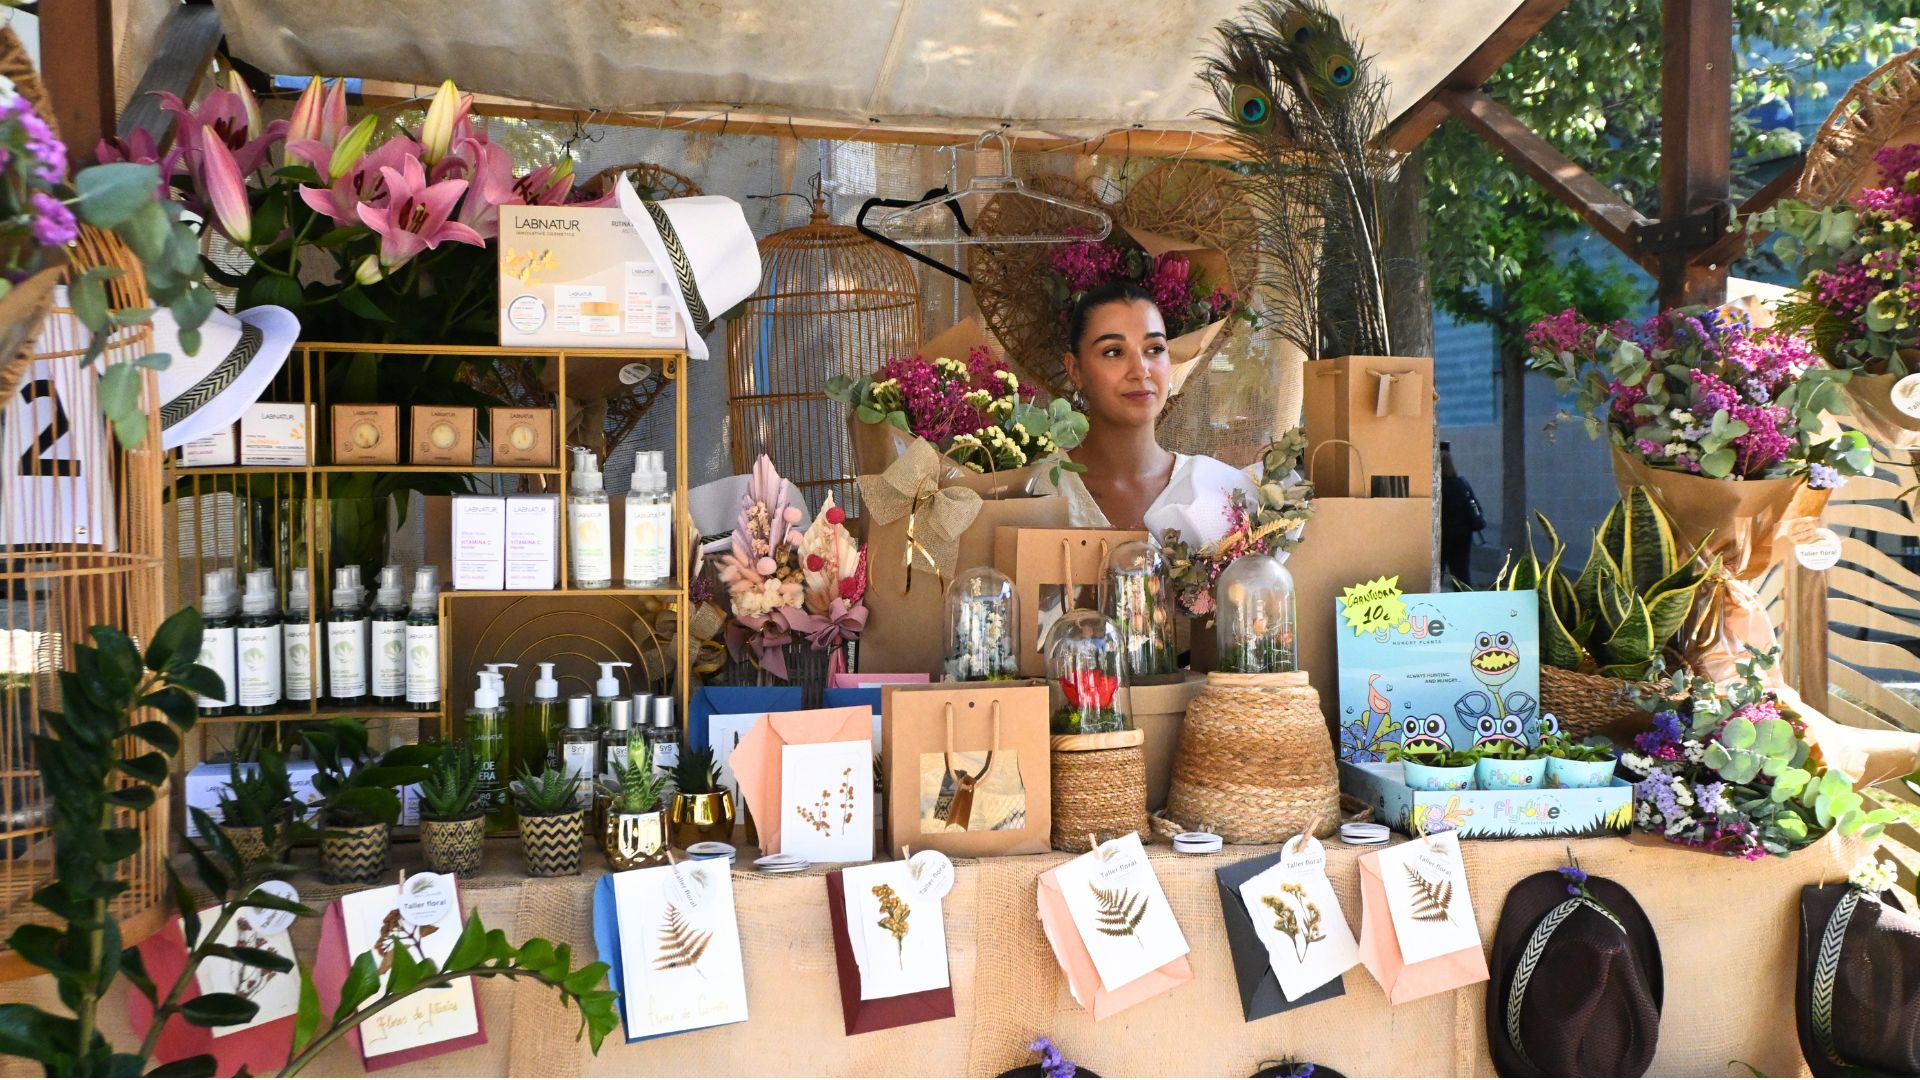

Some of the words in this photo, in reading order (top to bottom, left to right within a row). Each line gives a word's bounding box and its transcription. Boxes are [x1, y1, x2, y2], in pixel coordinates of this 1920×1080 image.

[515, 216, 580, 231] LABNATUR
[18, 379, 81, 476] 2
[479, 771, 496, 781] ERA
[1100, 868, 1118, 878] Taller
[1119, 858, 1137, 872] floral
[1286, 861, 1304, 869] Taller
[1305, 857, 1322, 865] floral
[1419, 854, 1435, 867] Taller
[1436, 863, 1452, 877] floral
[404, 902, 425, 910] Taller
[426, 899, 447, 907] floral
